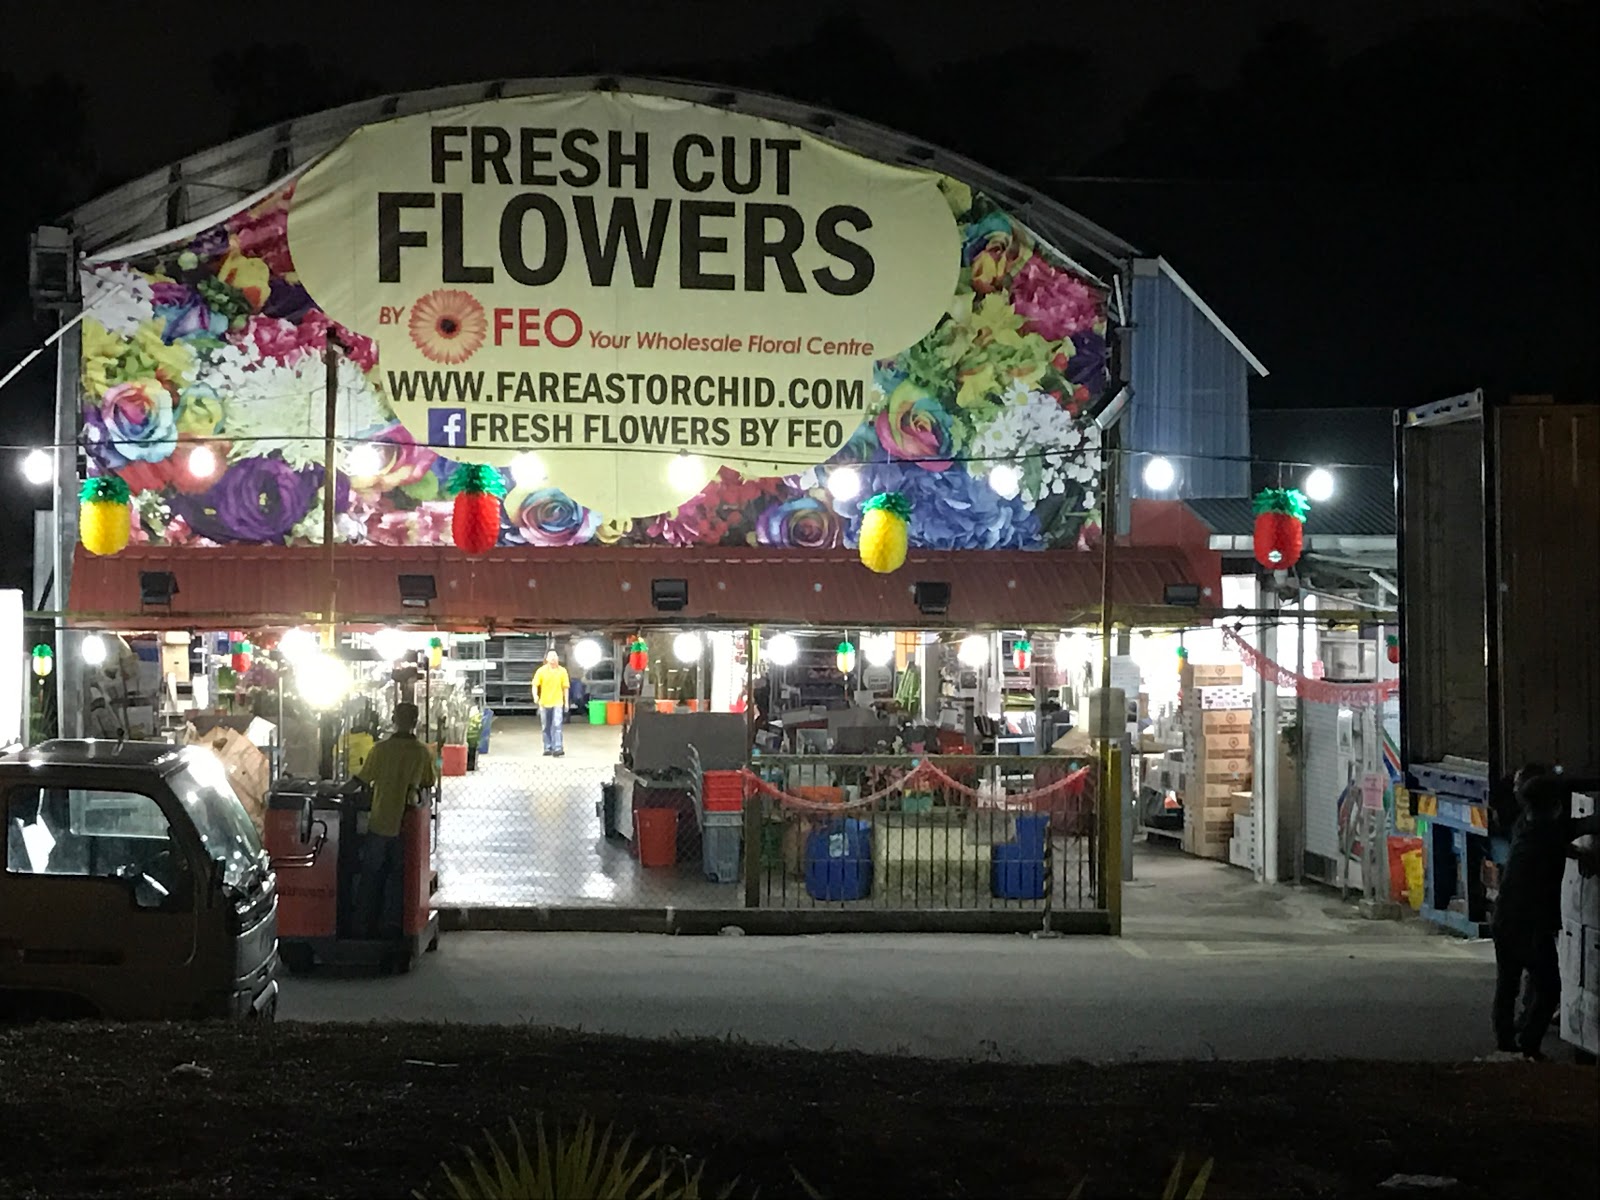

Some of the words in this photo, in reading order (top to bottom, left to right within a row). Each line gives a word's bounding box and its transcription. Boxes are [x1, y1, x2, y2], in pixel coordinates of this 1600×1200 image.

[431, 127, 649, 189] FRESH
[672, 134, 801, 196] CUT
[379, 192, 875, 295] FLOWERS
[380, 306, 405, 325] BY
[494, 308, 583, 348] FEO
[589, 331, 631, 349] Your
[637, 331, 743, 352] Wholesale
[749, 335, 802, 354] Floral
[807, 337, 874, 356] Centre
[388, 371, 864, 409] WWW.FAREASTORCHID.COM
[471, 413, 573, 442] FRESH
[584, 414, 730, 447] FLOWERS
[740, 418, 780, 447] BY
[788, 419, 844, 448] FEO
